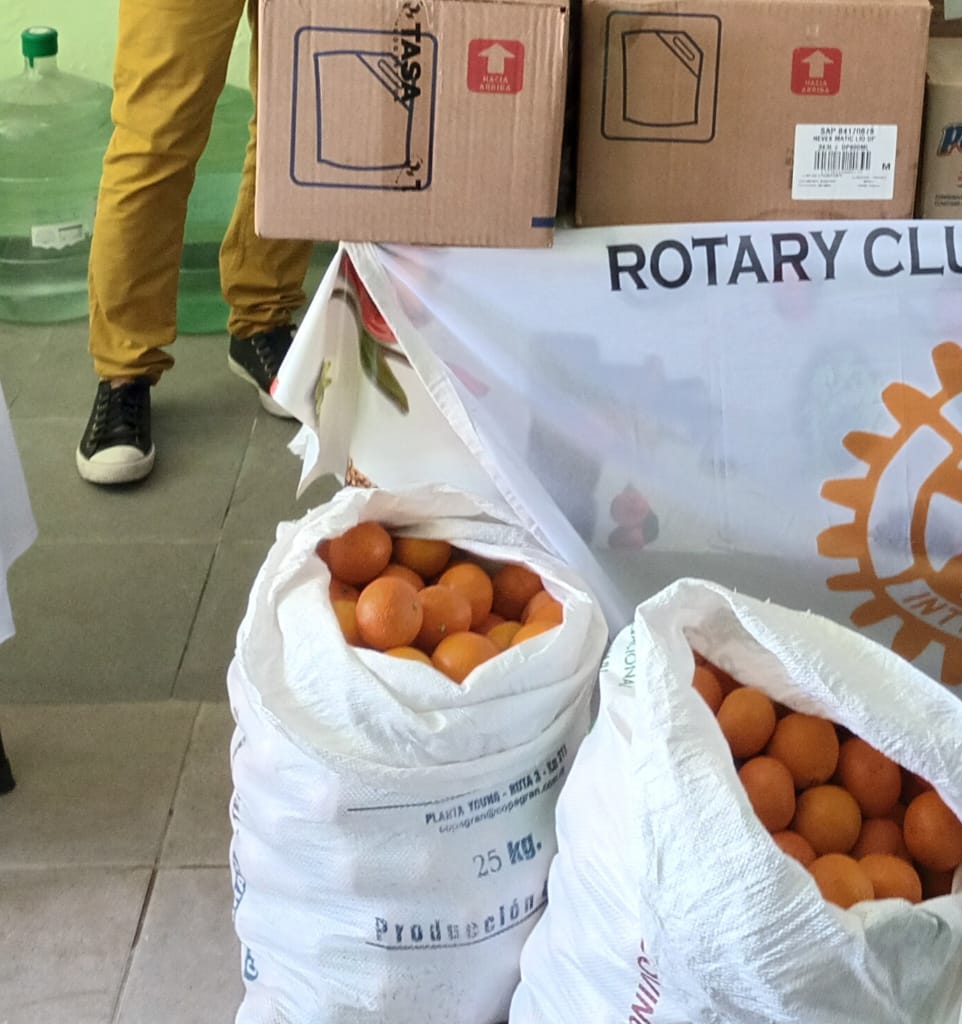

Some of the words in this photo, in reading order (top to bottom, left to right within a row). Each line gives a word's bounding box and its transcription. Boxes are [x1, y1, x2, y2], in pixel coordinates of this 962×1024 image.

[401, 22, 422, 102] TASA
[881, 162, 891, 171] M
[607, 228, 848, 292] ROTARY
[472, 848, 503, 878] 25
[506, 832, 543, 865] kg.
